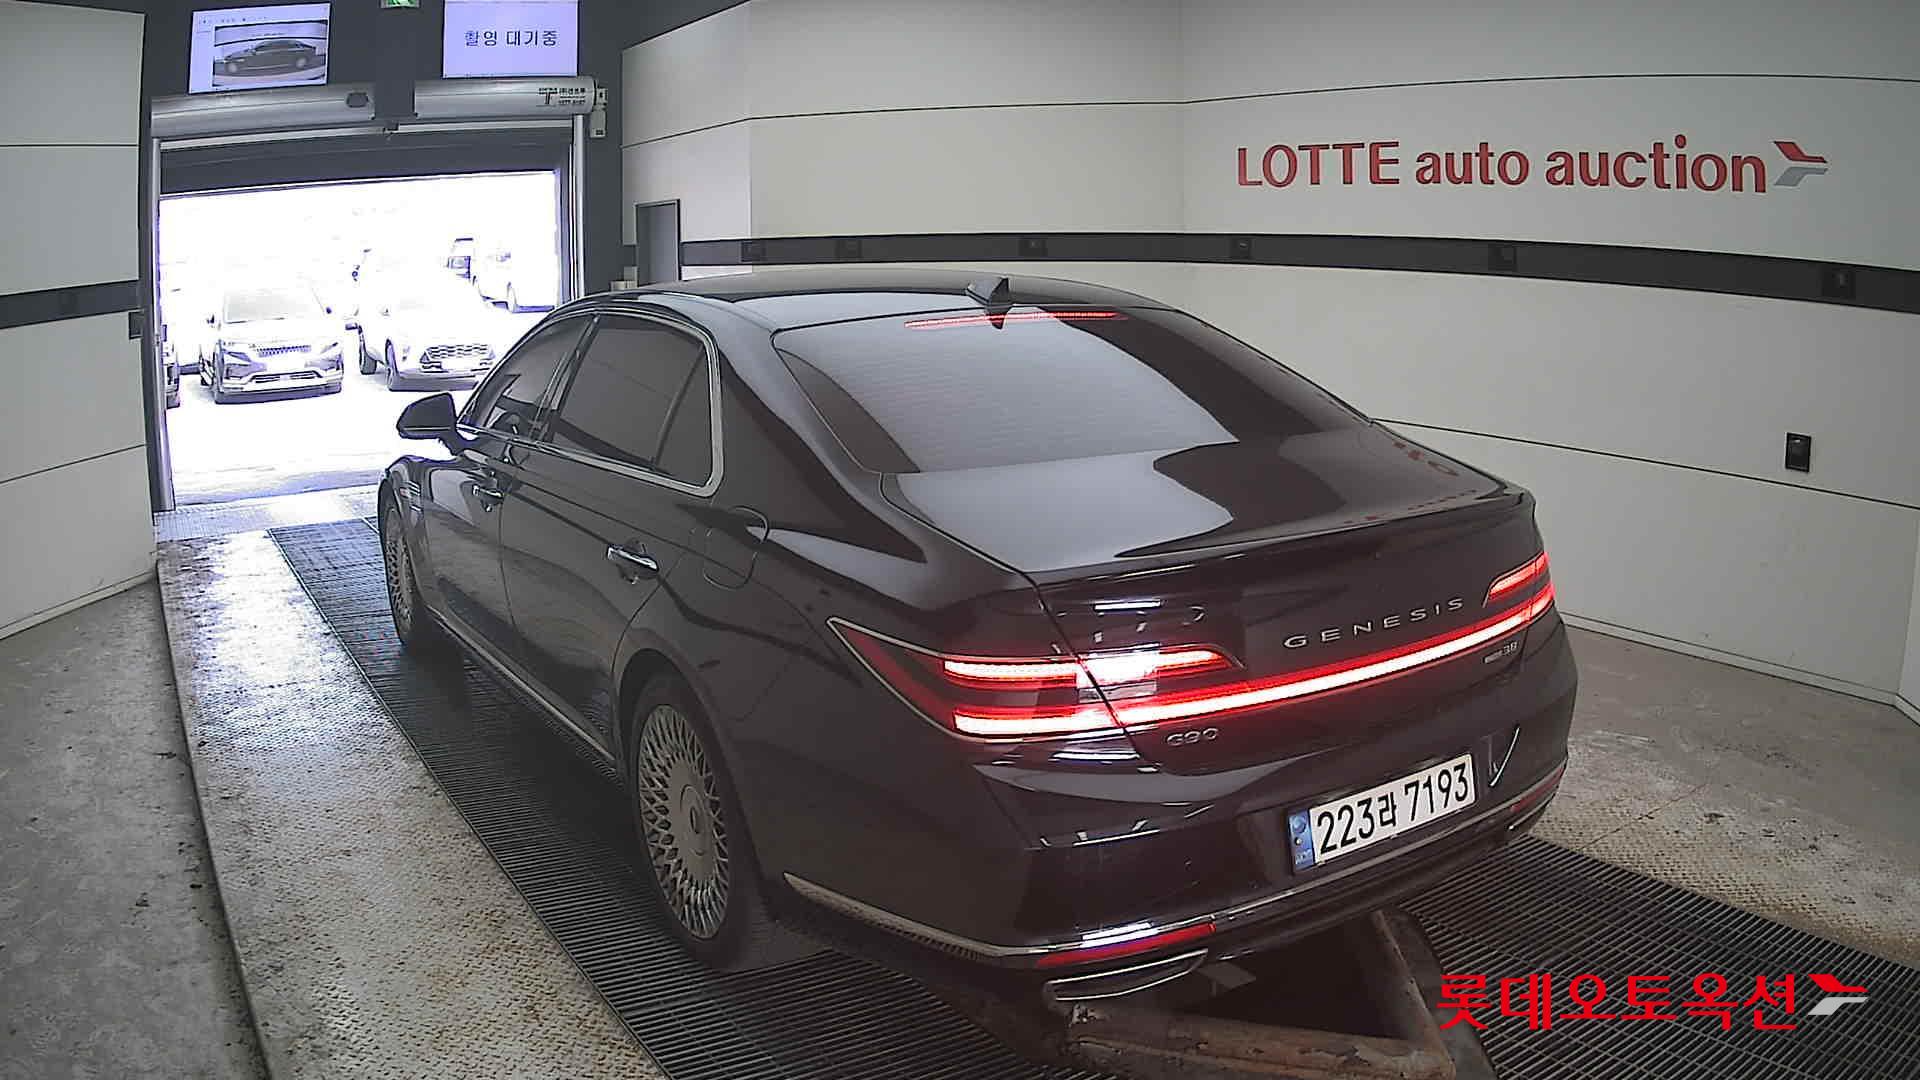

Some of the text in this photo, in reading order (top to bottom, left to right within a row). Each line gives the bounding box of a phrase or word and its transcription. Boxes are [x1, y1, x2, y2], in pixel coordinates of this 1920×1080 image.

[506, 30, 558, 47] 대기중
[1238, 133, 1767, 193] LOTTE auto auction
[1283, 597, 1464, 648] GENESIS
[1166, 727, 1219, 746] G90
[1316, 762, 1470, 855] 223라 7193
